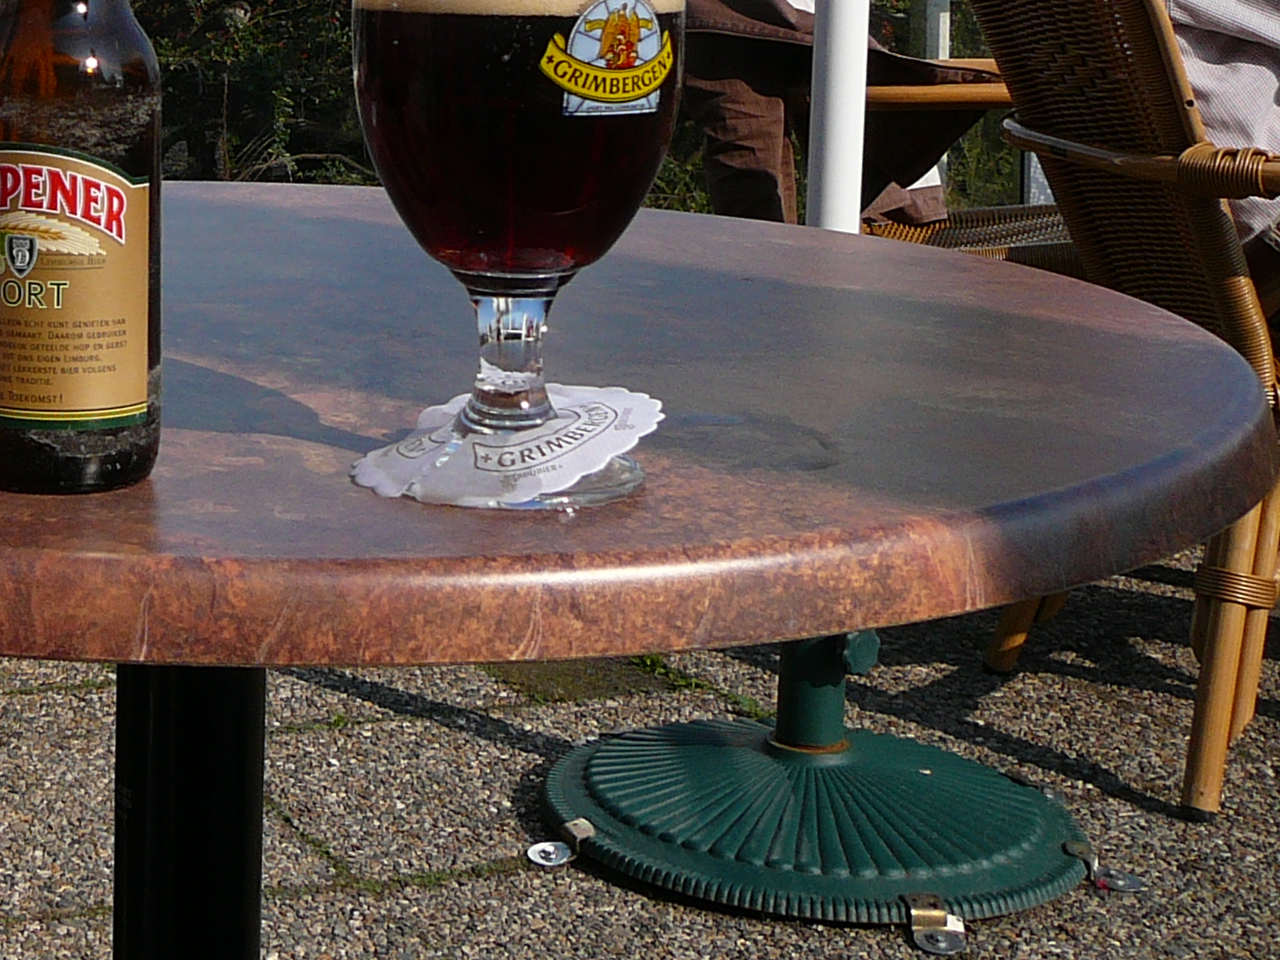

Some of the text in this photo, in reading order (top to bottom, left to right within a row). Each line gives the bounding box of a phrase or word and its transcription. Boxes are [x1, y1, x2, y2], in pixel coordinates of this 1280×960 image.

[553, 57, 668, 95] GRIMBERGEN
[72, 319, 110, 329] GENIETEN
[30, 343, 70, 352] GETEELDE
[73, 343, 90, 351] HOP
[37, 355, 61, 363] EIGEN
[61, 366, 79, 375] BIER
[82, 363, 117, 374] VOLGENS
